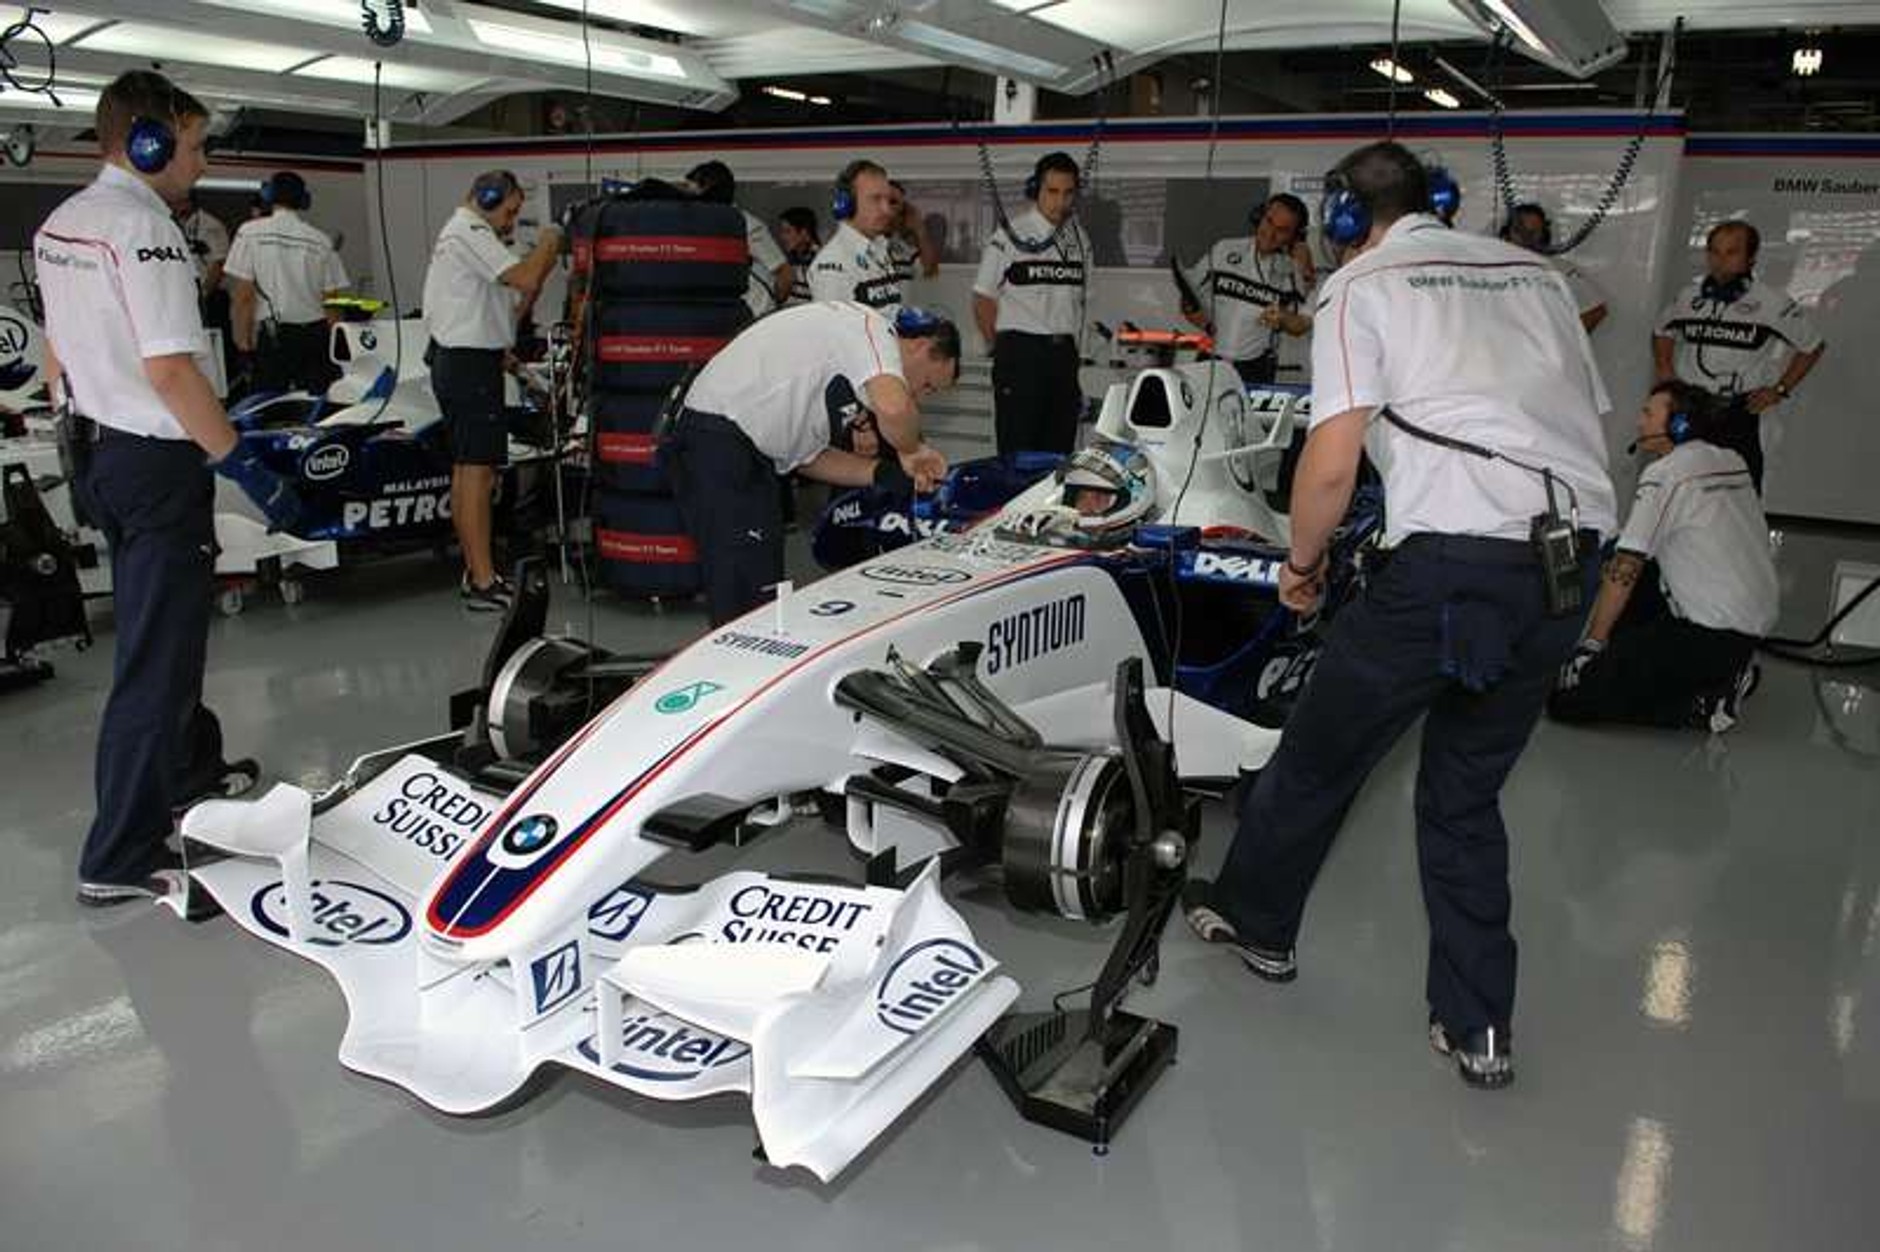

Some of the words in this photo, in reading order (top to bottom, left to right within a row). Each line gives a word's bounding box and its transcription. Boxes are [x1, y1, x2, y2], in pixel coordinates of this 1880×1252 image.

[1773, 179, 1820, 192] BMW
[809, 601, 856, 616] 9
[713, 631, 810, 659] SYNTIUM
[988, 593, 1085, 675] SYNTIUM
[401, 772, 492, 833] CREDI
[730, 885, 873, 930] CREDIT
[879, 953, 979, 1020] intel
